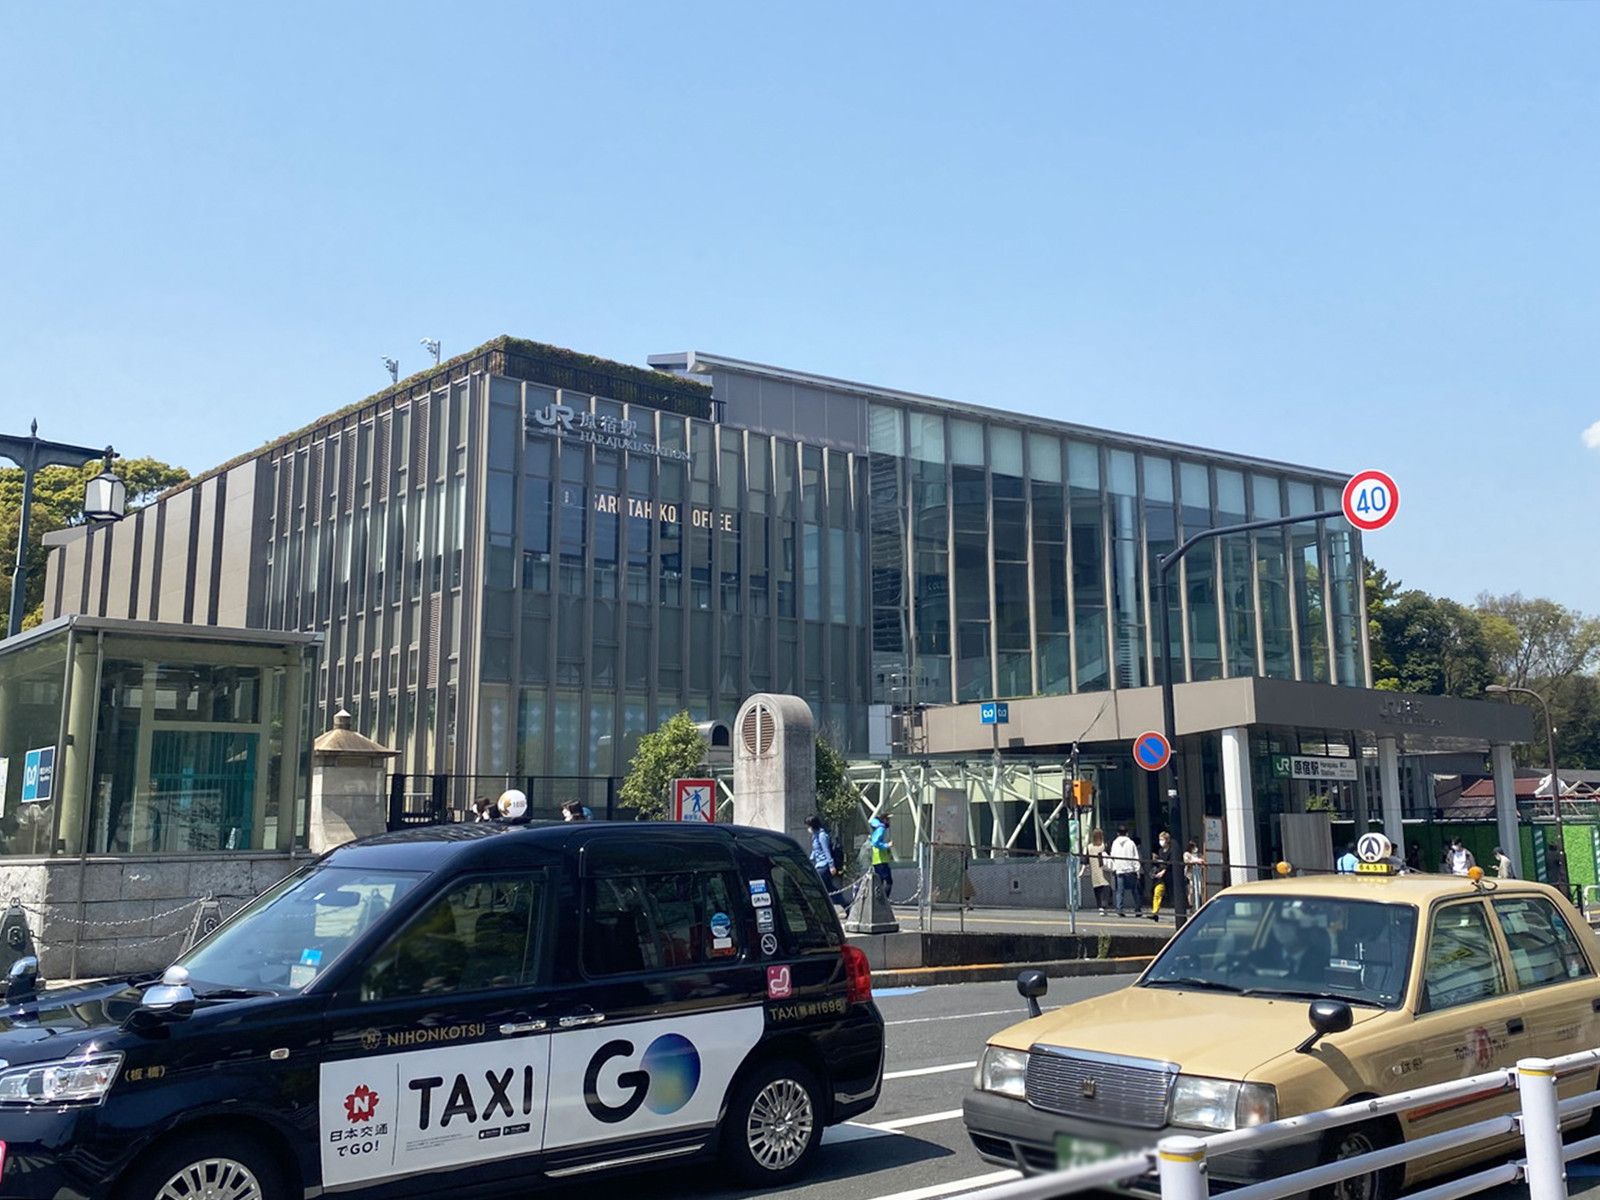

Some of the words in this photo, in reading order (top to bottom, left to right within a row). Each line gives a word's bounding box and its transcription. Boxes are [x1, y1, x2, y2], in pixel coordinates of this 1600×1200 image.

[535, 403, 574, 430] JR
[580, 411, 637, 438] 原宿駅
[580, 431, 641, 452] HARAJUKU
[642, 443, 691, 460] STATION
[1357, 486, 1386, 514] 40
[1276, 758, 1290, 771] JR
[387, 1023, 486, 1047] NIHONKOTSU
[408, 1065, 533, 1131] TAXI
[583, 1033, 701, 1124] GO
[353, 1096, 369, 1114] N
[330, 1123, 388, 1142] 日本交通
[337, 1140, 379, 1157] でGO!
